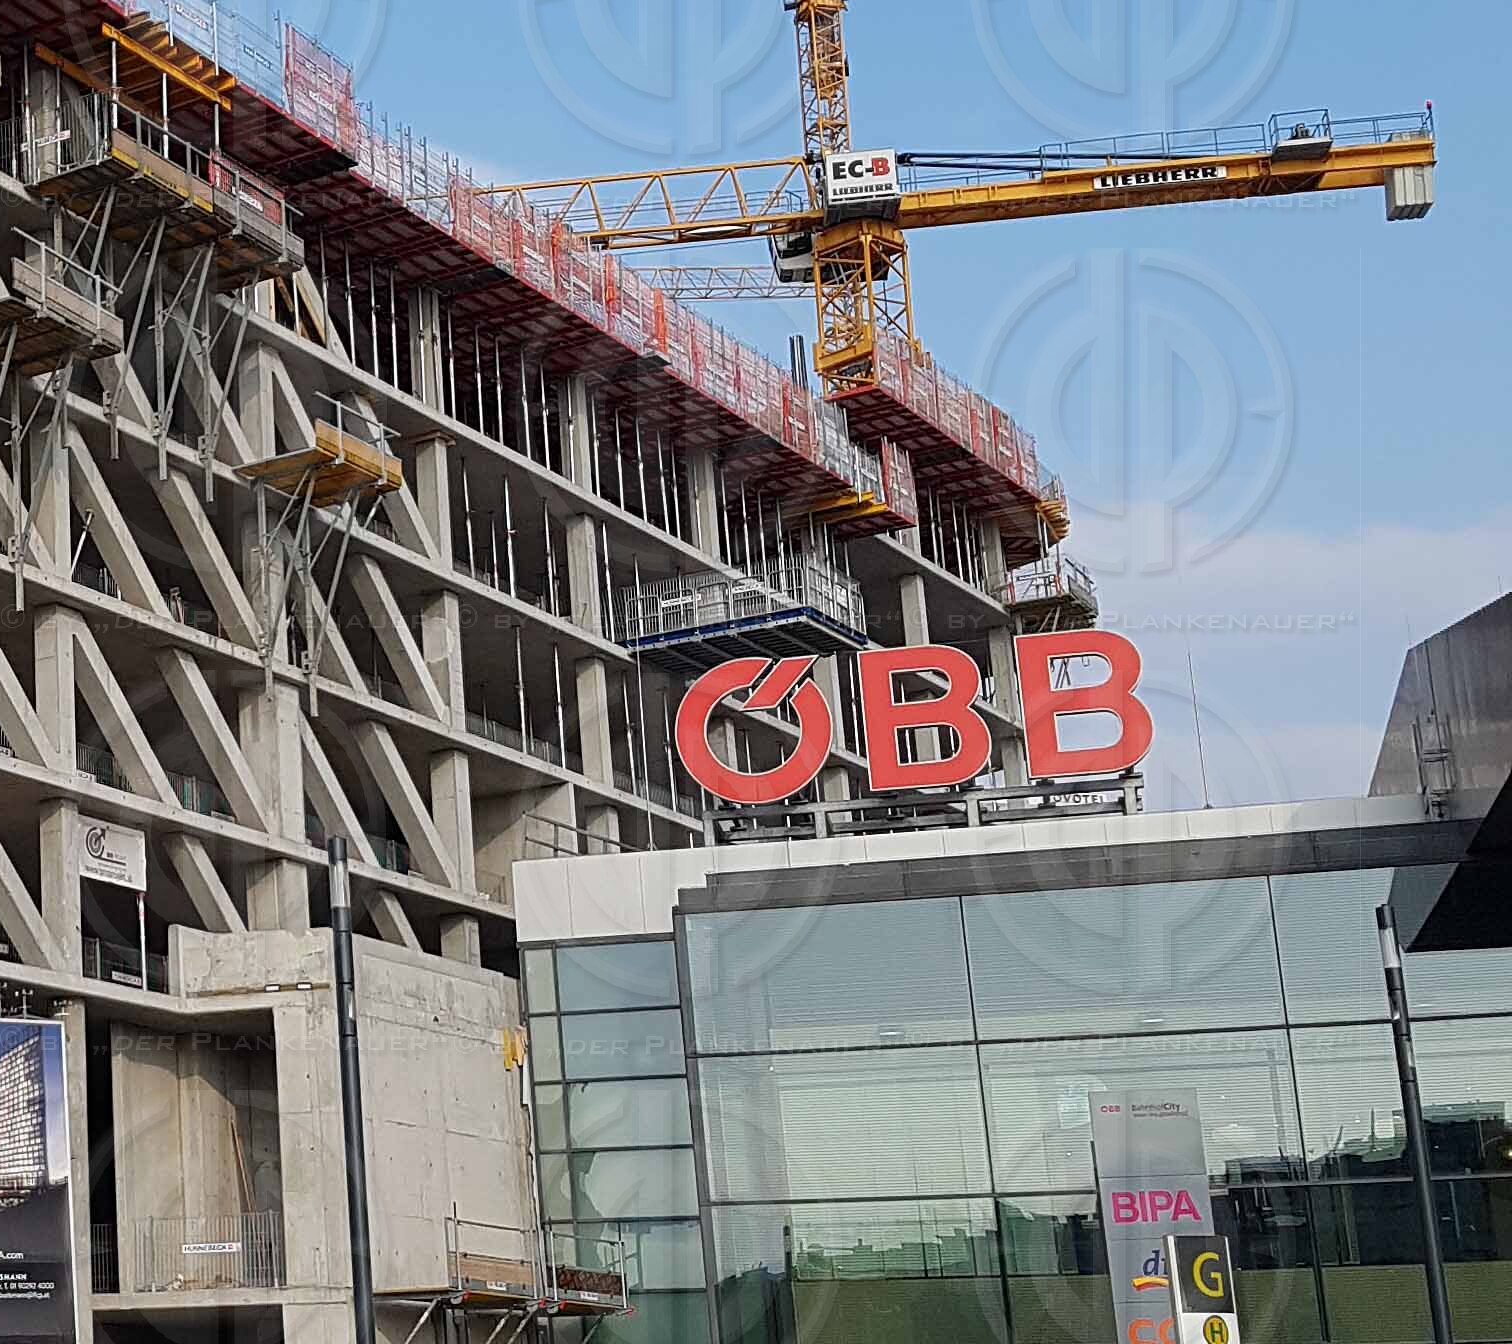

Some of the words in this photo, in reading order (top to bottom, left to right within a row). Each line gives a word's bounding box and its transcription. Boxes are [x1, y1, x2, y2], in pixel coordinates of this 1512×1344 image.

[832, 157, 890, 180] EC-B
[1100, 167, 1218, 188] LIEBHERR
[675, 628, 1154, 805] ÖBB
[1111, 1189, 1202, 1224] BIPA
[1192, 1251, 1225, 1298] G
